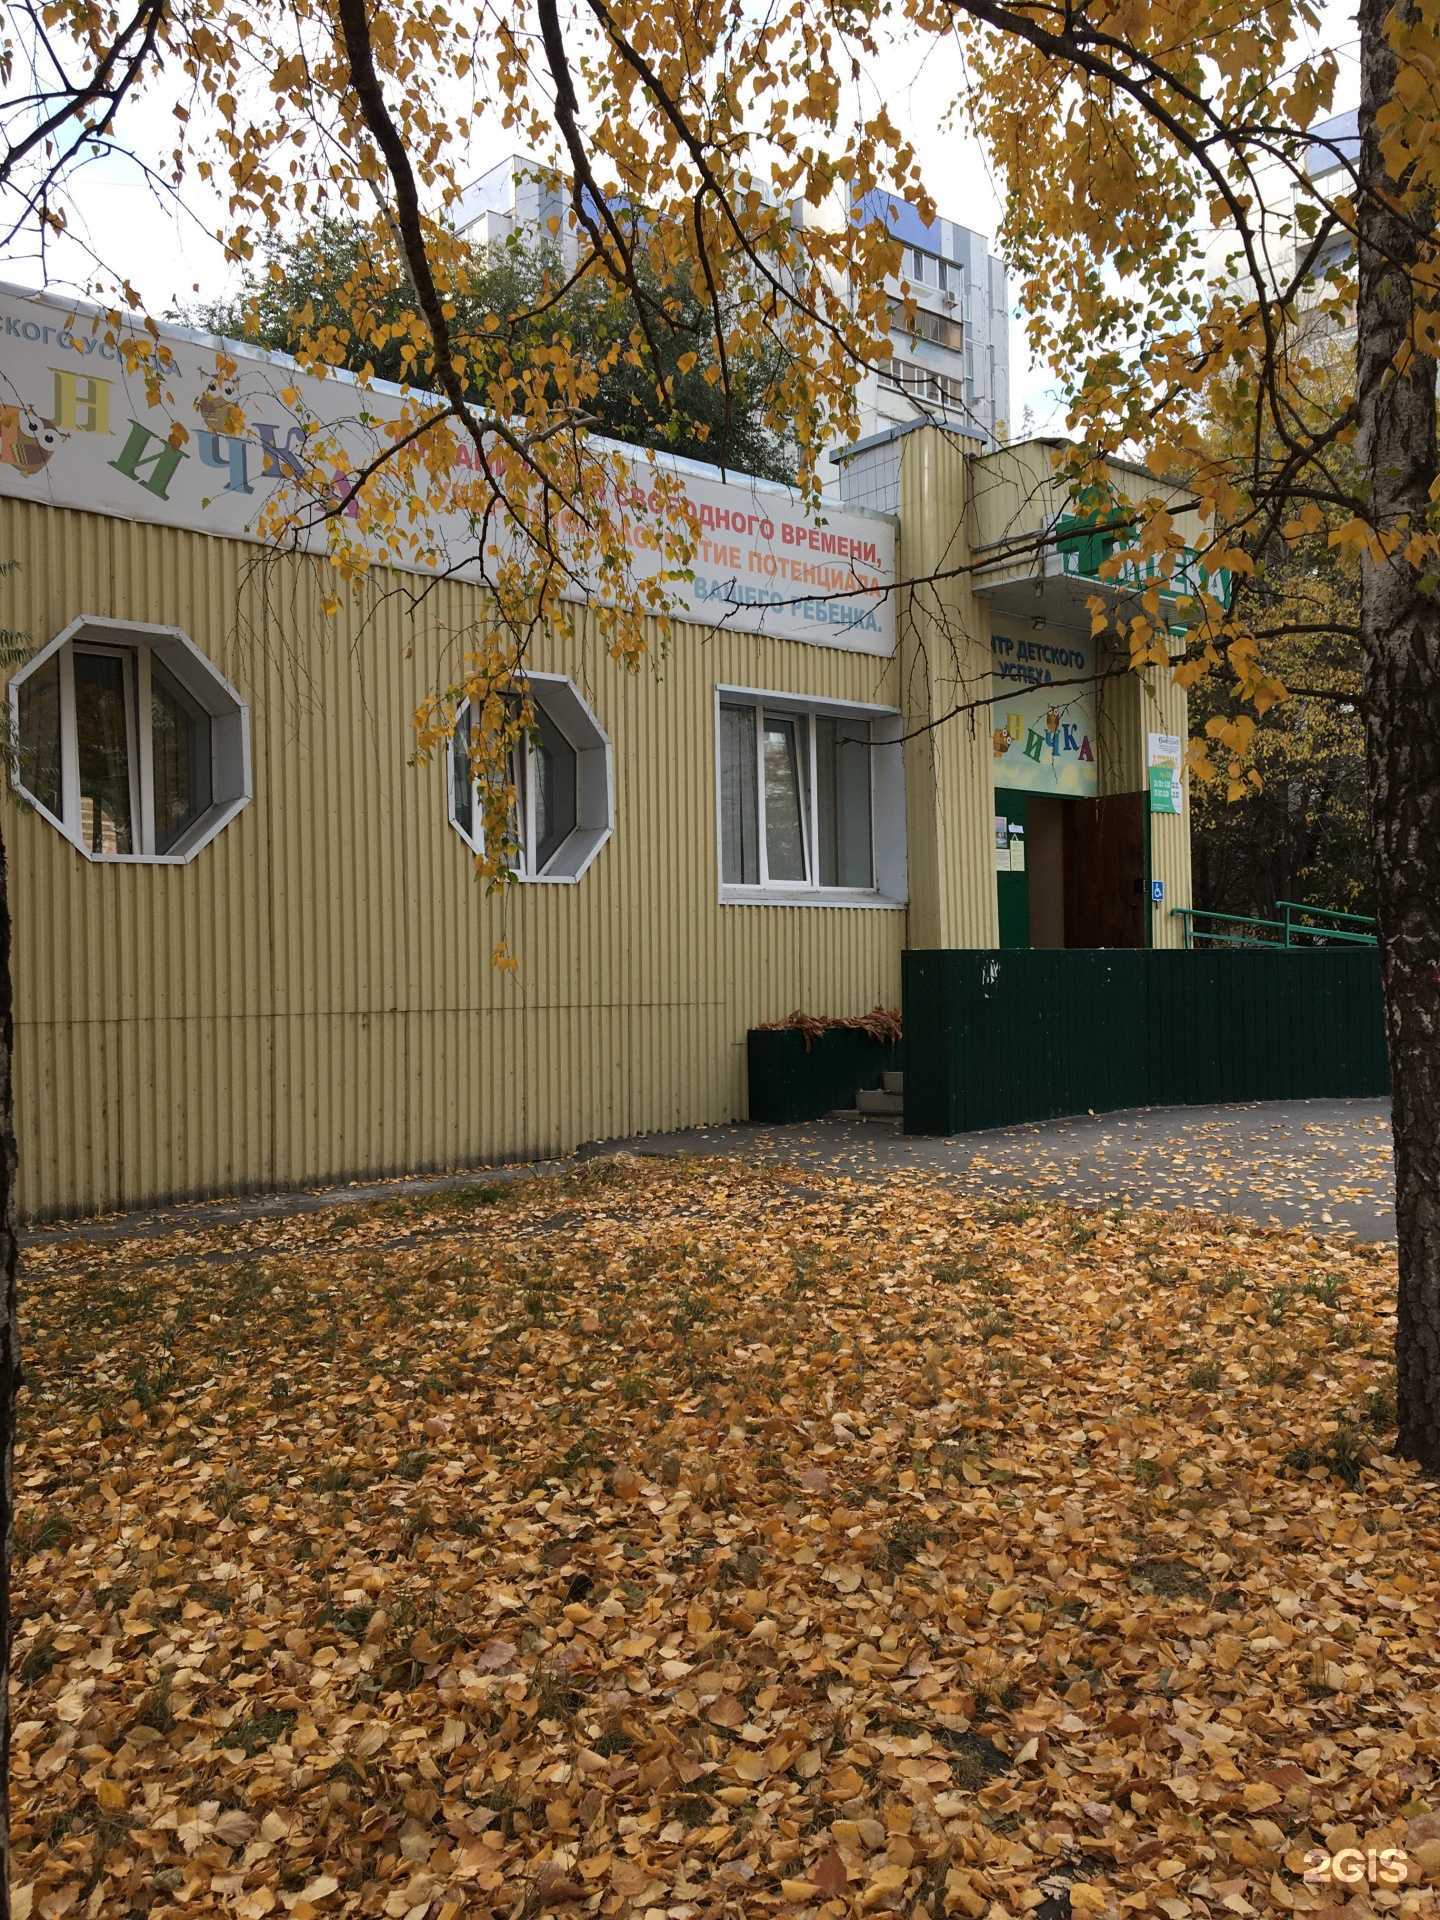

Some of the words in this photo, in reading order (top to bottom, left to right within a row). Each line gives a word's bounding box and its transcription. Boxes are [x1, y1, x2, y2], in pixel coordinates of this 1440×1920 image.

[0, 315, 84, 349] КОГО
[781, 521, 882, 569] ВРЕМЕНИ,
[748, 549, 882, 598] ПОТЕНЦИАЛА
[694, 575, 785, 615] ВАШЕГО
[1017, 639, 1085, 670] ДЕТСКОГО
